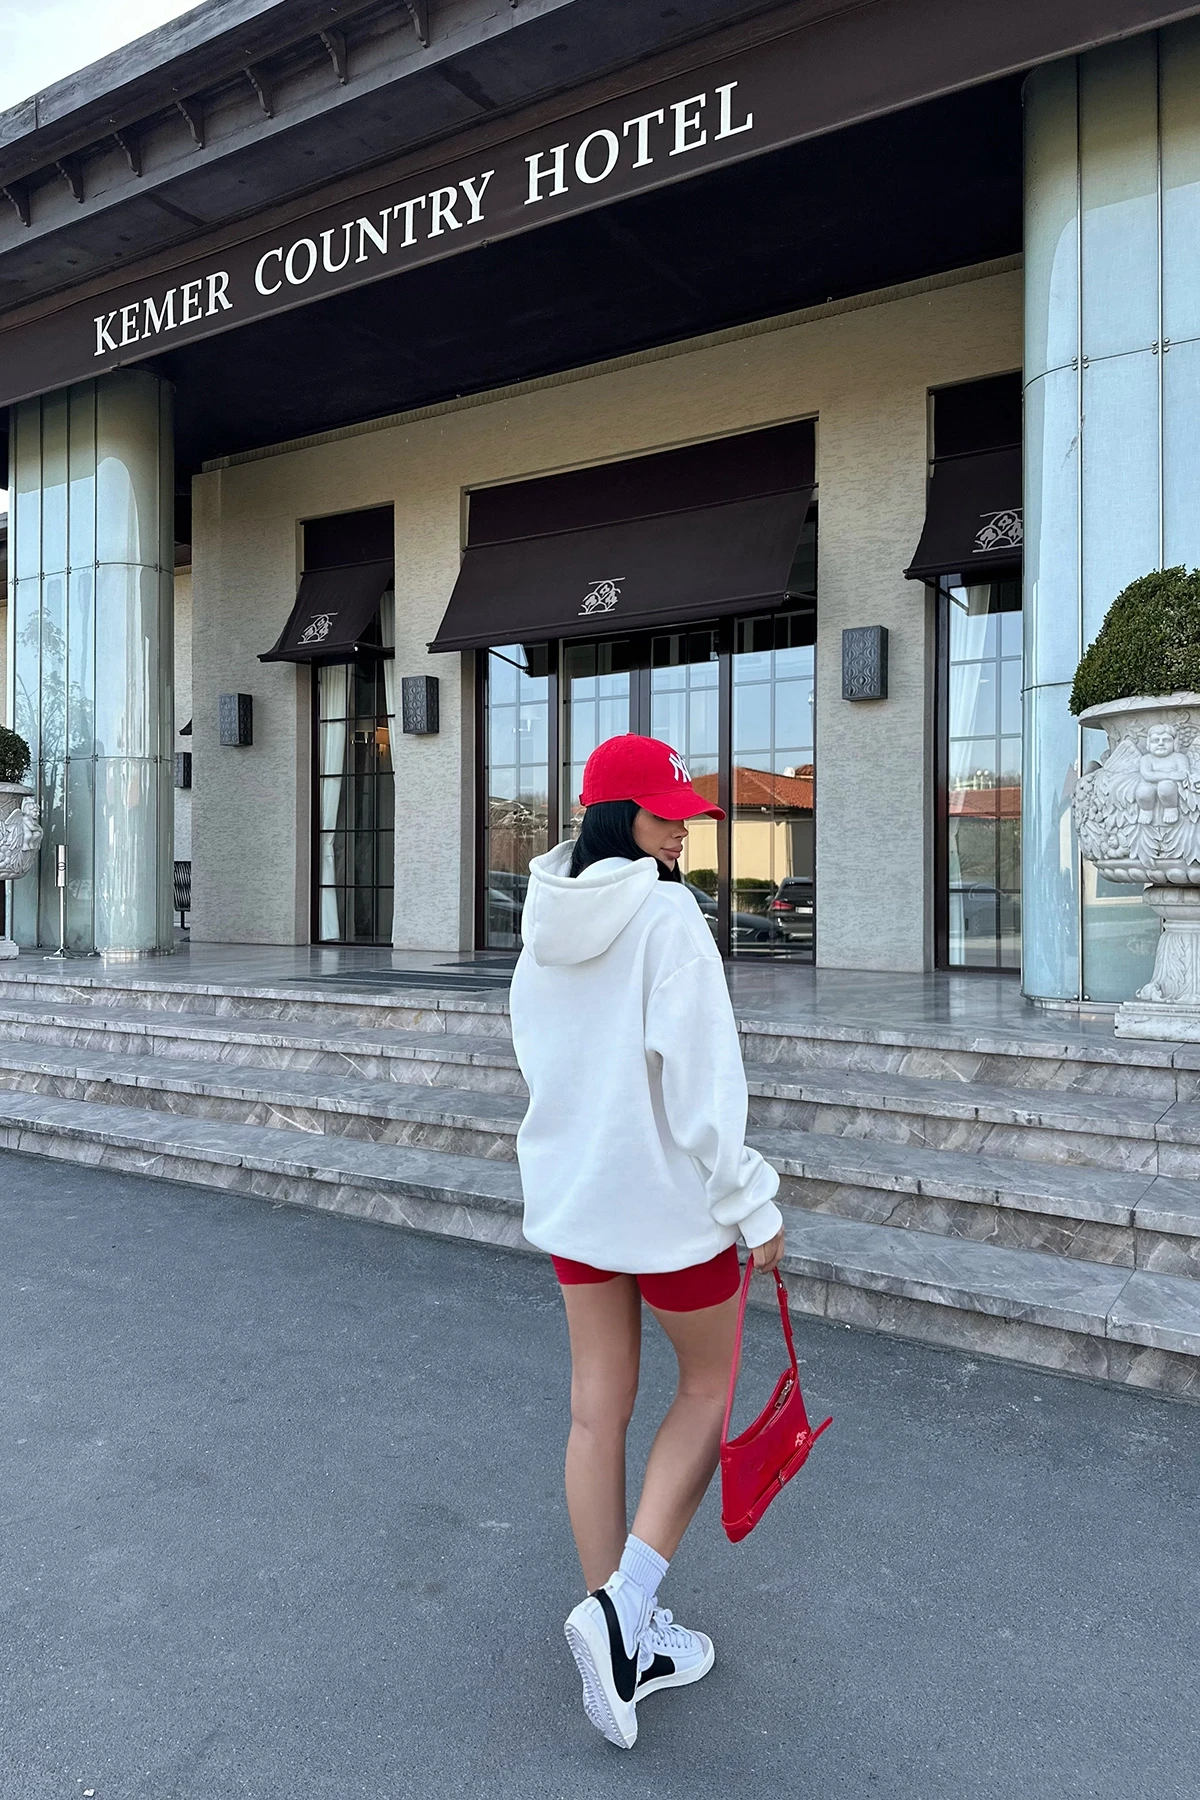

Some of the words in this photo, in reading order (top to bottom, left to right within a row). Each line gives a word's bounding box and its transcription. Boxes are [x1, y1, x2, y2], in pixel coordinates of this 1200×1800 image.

[93, 271, 233, 357] KEMER
[254, 169, 495, 296] COUNTRY
[523, 80, 753, 206] HOTEL
